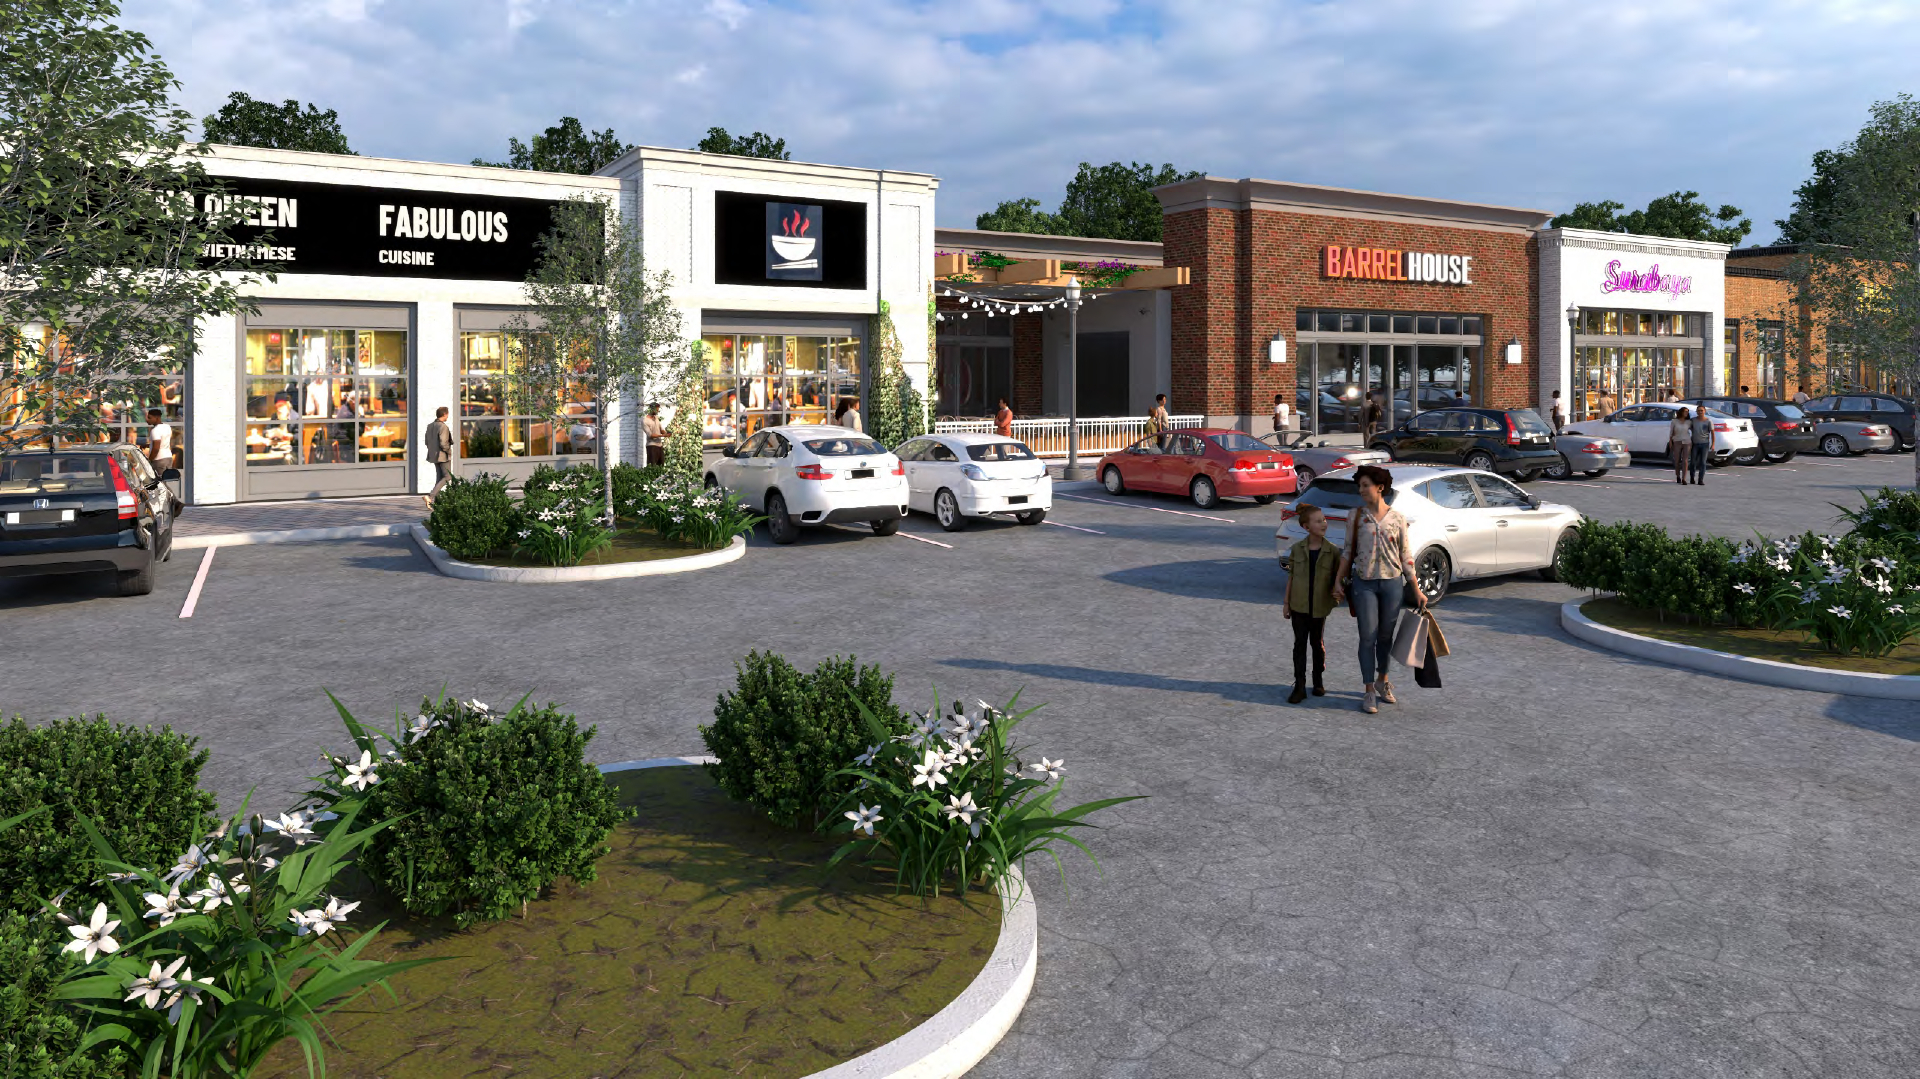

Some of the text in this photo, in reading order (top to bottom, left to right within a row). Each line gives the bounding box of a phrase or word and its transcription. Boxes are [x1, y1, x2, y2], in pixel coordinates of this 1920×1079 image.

[379, 204, 508, 242] FABULOUS
[202, 243, 296, 261] VIETNAMESE
[379, 249, 435, 265] CUISINE
[1603, 259, 1692, 300] Surabaya
